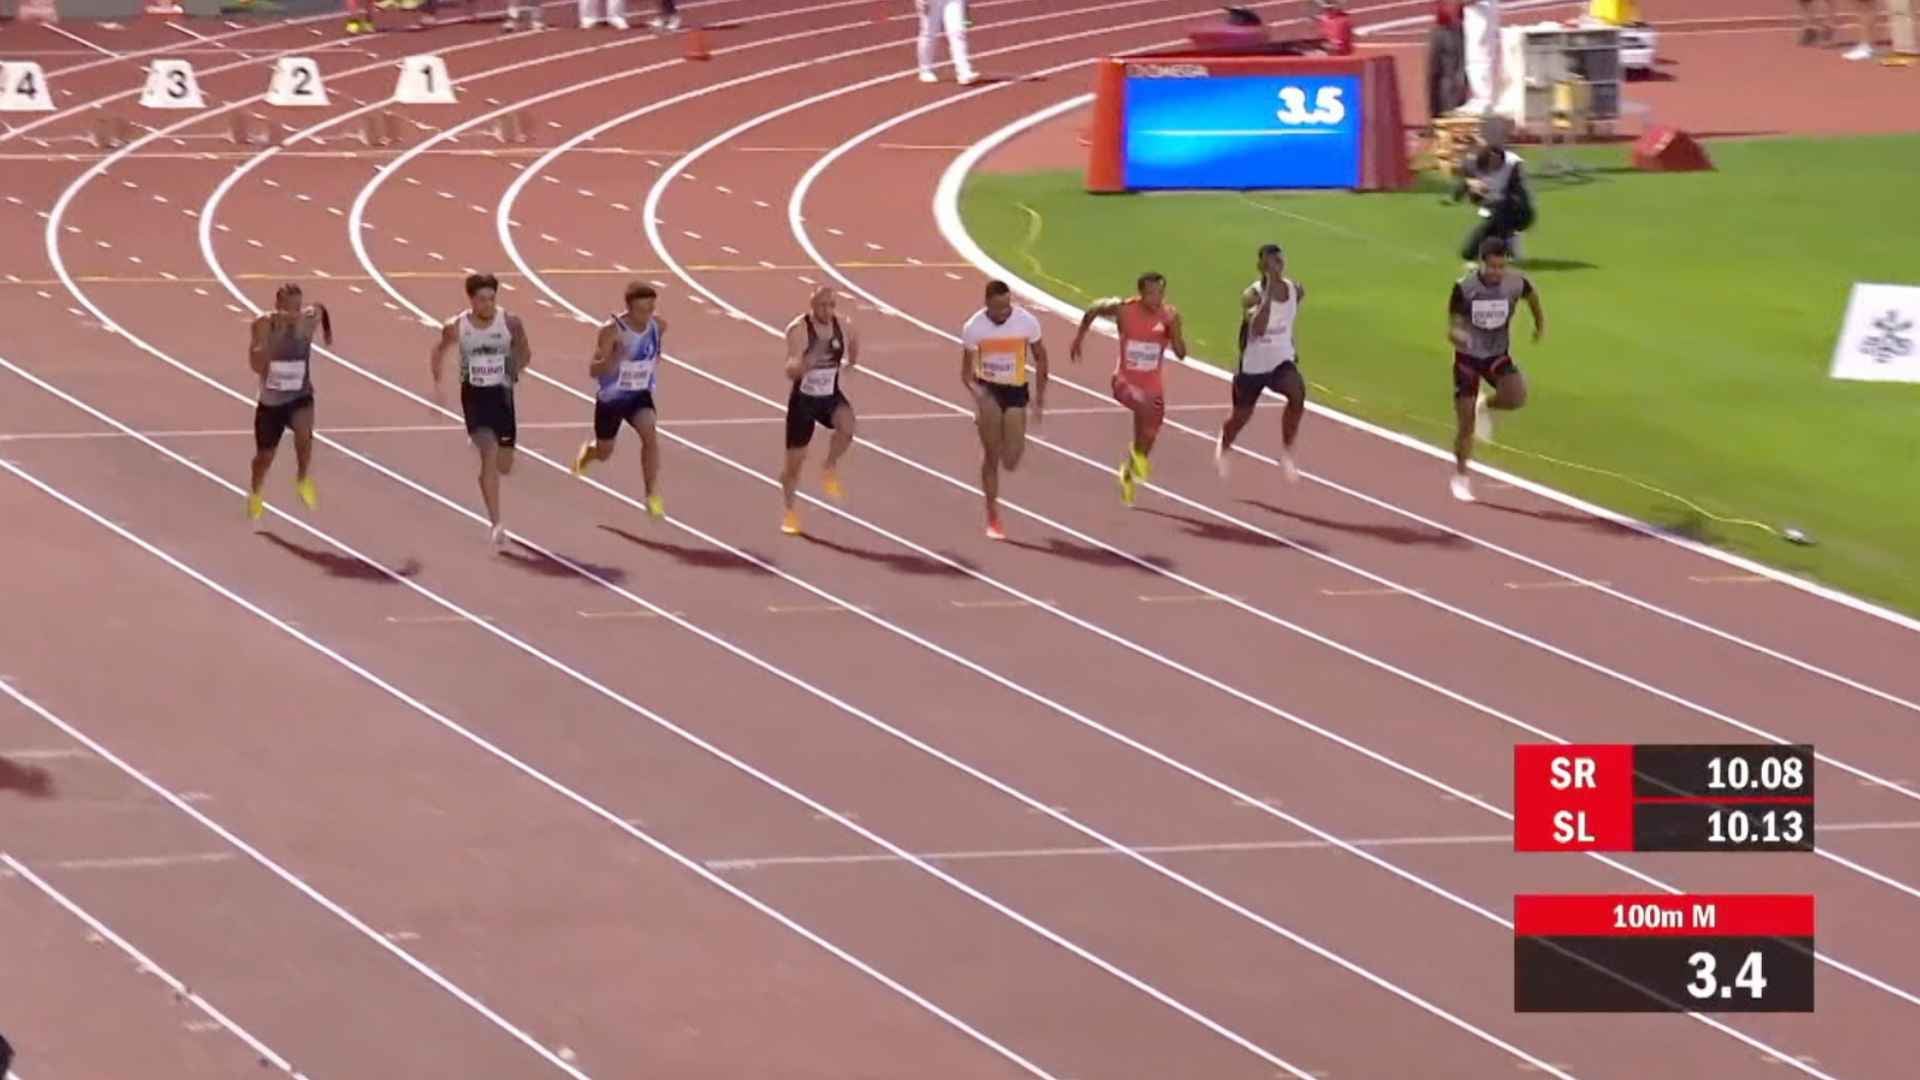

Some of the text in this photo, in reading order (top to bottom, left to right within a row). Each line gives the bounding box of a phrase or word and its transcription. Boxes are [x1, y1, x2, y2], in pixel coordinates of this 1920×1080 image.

[17, 72, 37, 98] 4
[167, 70, 188, 98] 3
[291, 67, 312, 95] 2
[420, 66, 434, 93] 1
[1277, 86, 1345, 126] 3.5
